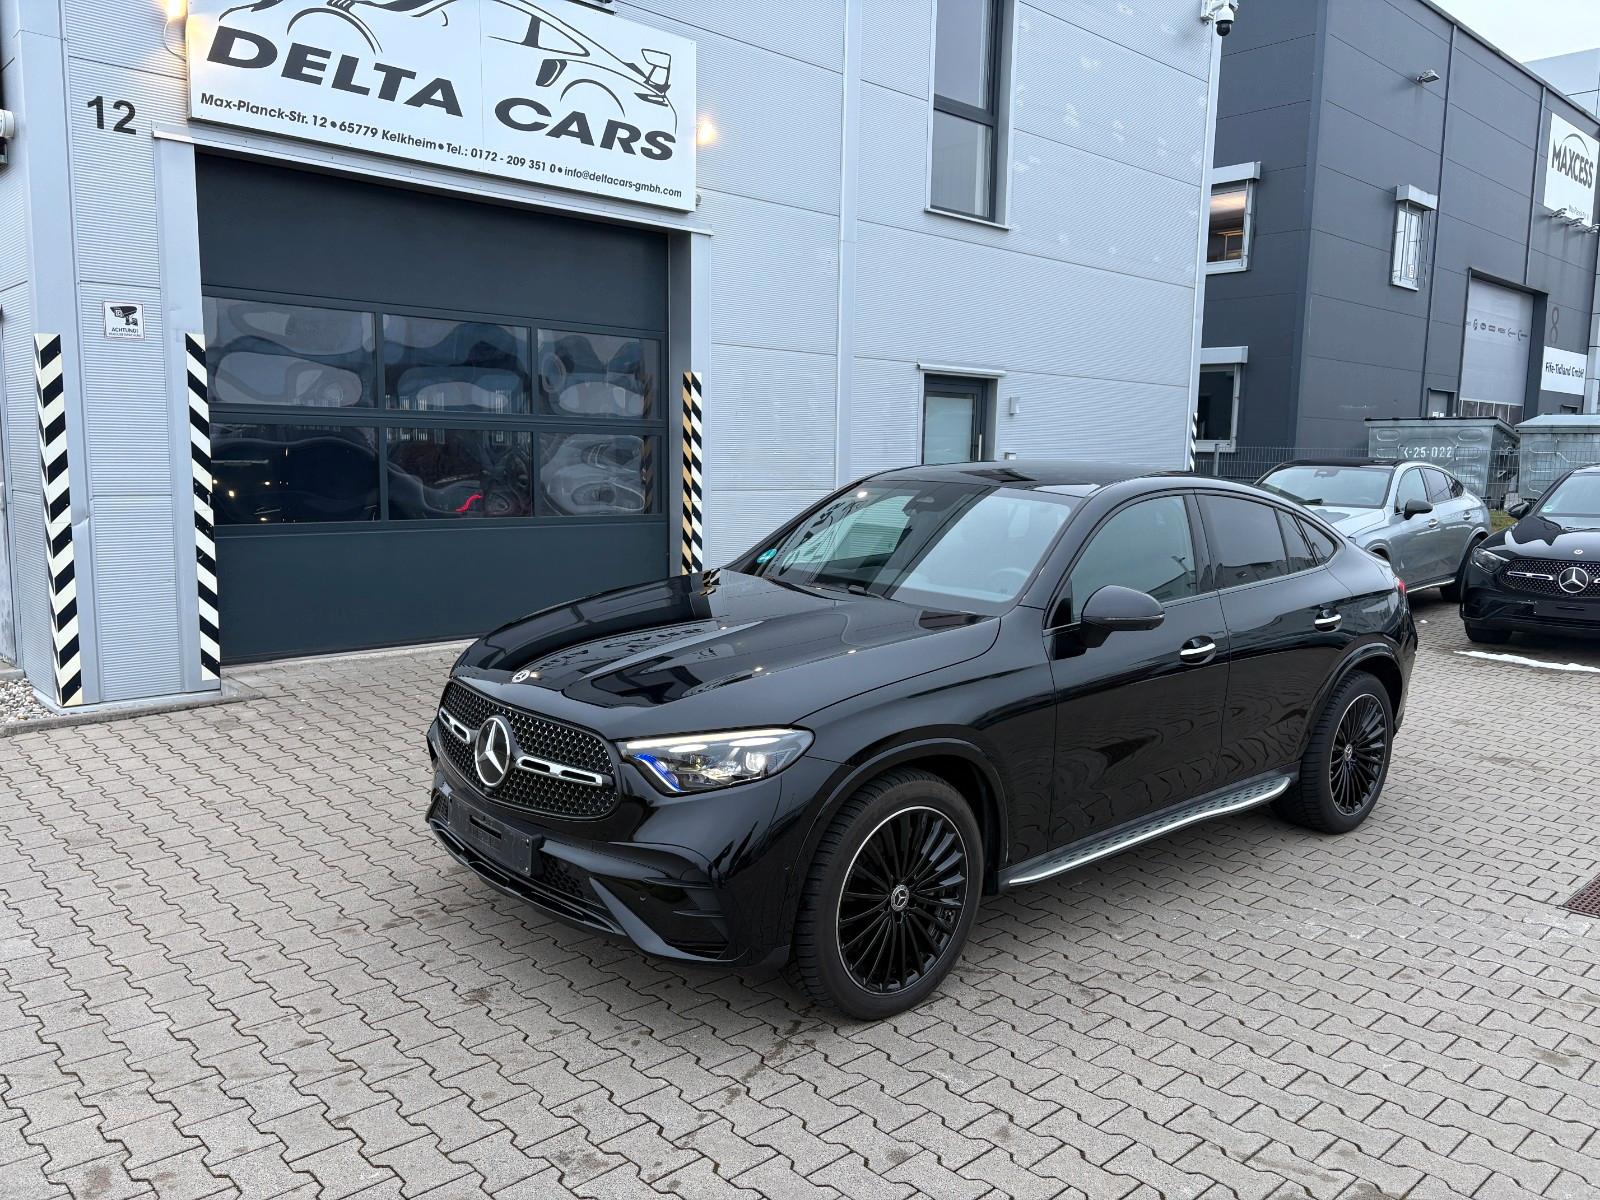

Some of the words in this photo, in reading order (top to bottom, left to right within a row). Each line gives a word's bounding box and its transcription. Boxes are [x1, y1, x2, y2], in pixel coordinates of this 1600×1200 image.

[87, 95, 137, 135] 12
[207, 25, 463, 117] DELTA
[495, 97, 677, 161] CARS
[200, 92, 309, 125] Max-Planck-Str.
[312, 114, 328, 128] 12
[339, 121, 378, 137] 65779
[381, 129, 437, 150] Kelkheim
[446, 142, 468, 157] Tel.:
[470, 147, 498, 162] 0172
[506, 155, 526, 167] 209
[528, 159, 546, 172] 351
[549, 163, 557, 174] 0
[564, 166, 683, 198] info@deltacars-gmbh.com
[1551, 137, 1594, 189] MAXCESS
[1551, 306, 1560, 344] 8
